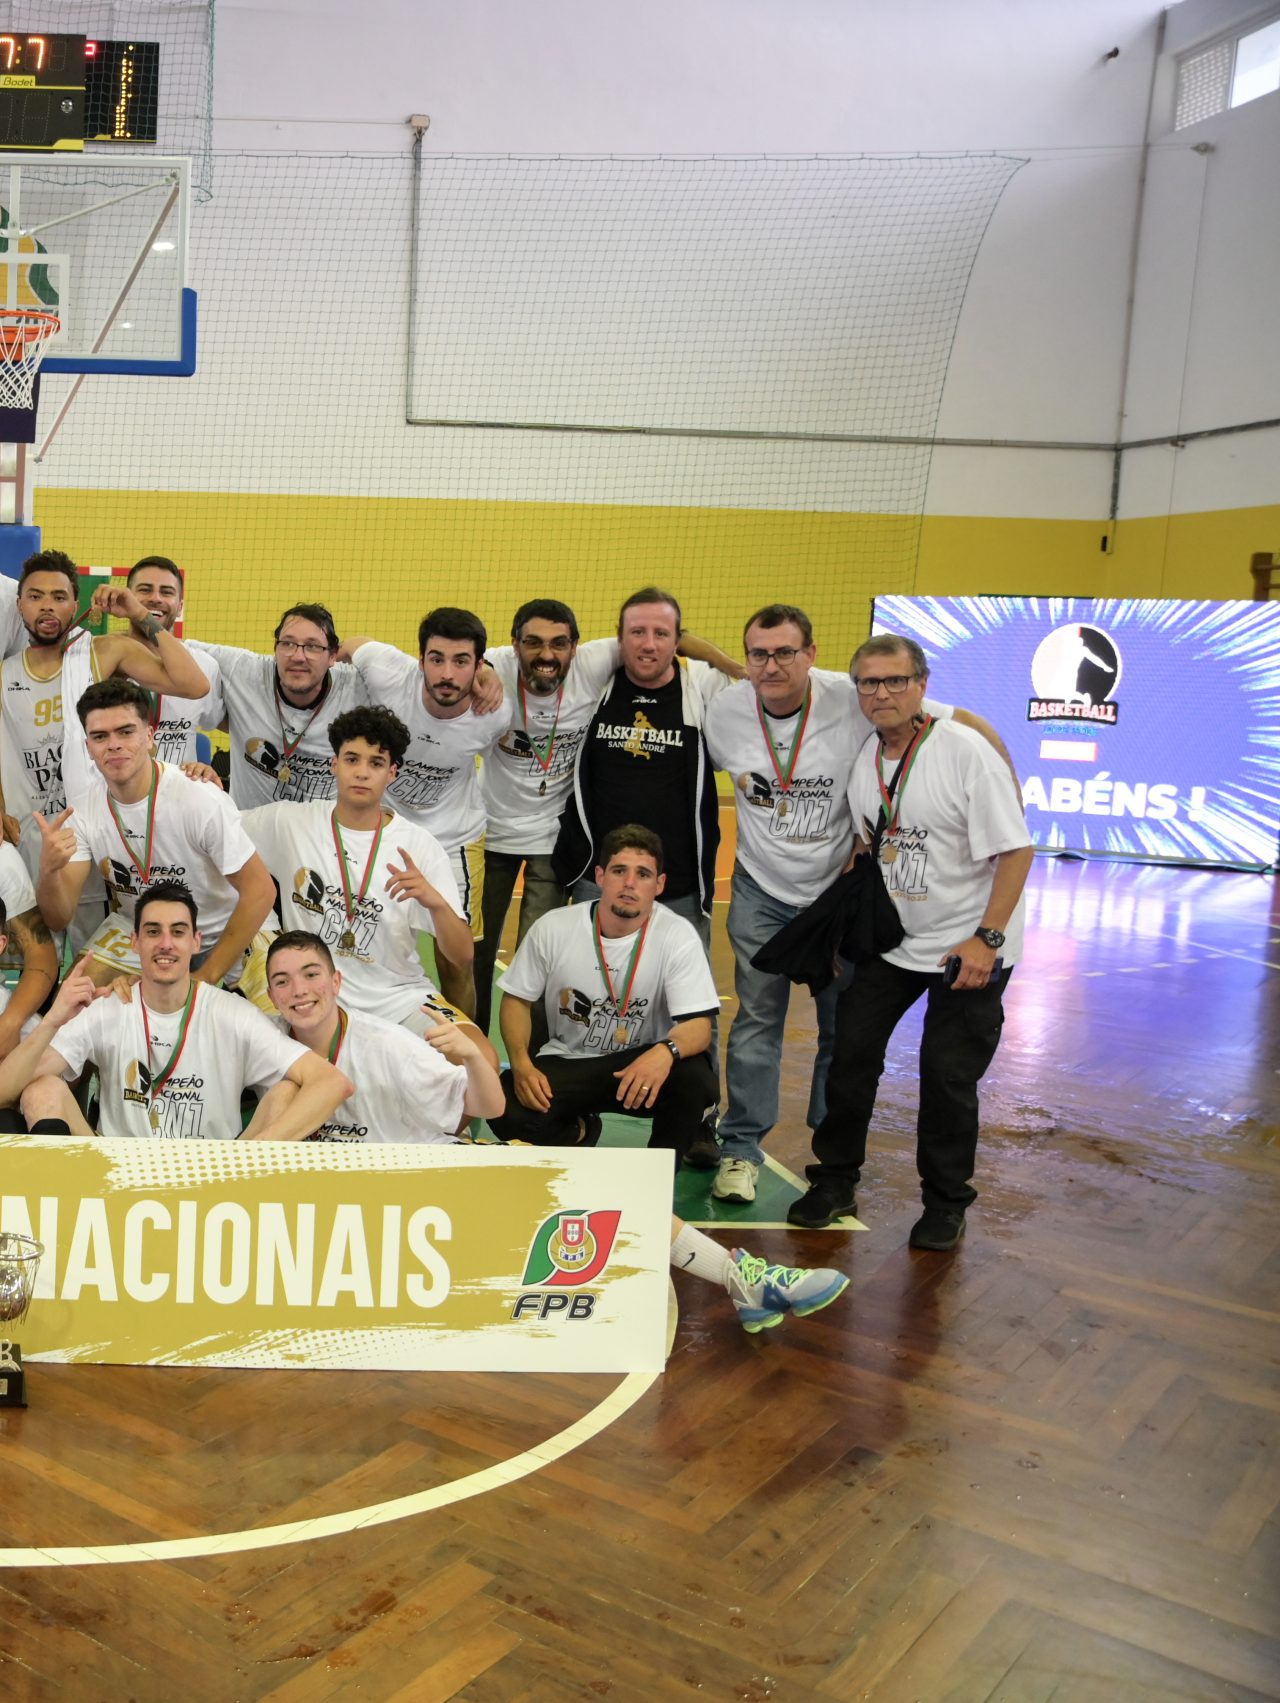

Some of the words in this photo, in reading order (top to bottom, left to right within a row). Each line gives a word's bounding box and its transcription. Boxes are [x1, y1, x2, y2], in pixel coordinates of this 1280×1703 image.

[3, 76, 34, 86] Bodet
[1029, 701, 1117, 722] BASKETBALL
[153, 732, 189, 741] CIONAL
[595, 722, 684, 747] BASKETBALL
[607, 740, 634, 749] SANTO
[639, 741, 666, 754] ANDRÉ
[771, 775, 834, 788] CMPEÃO
[769, 798, 833, 839] CN1
[0, 1195, 453, 1309] NACIONAIS
[509, 1291, 597, 1321] FPB
